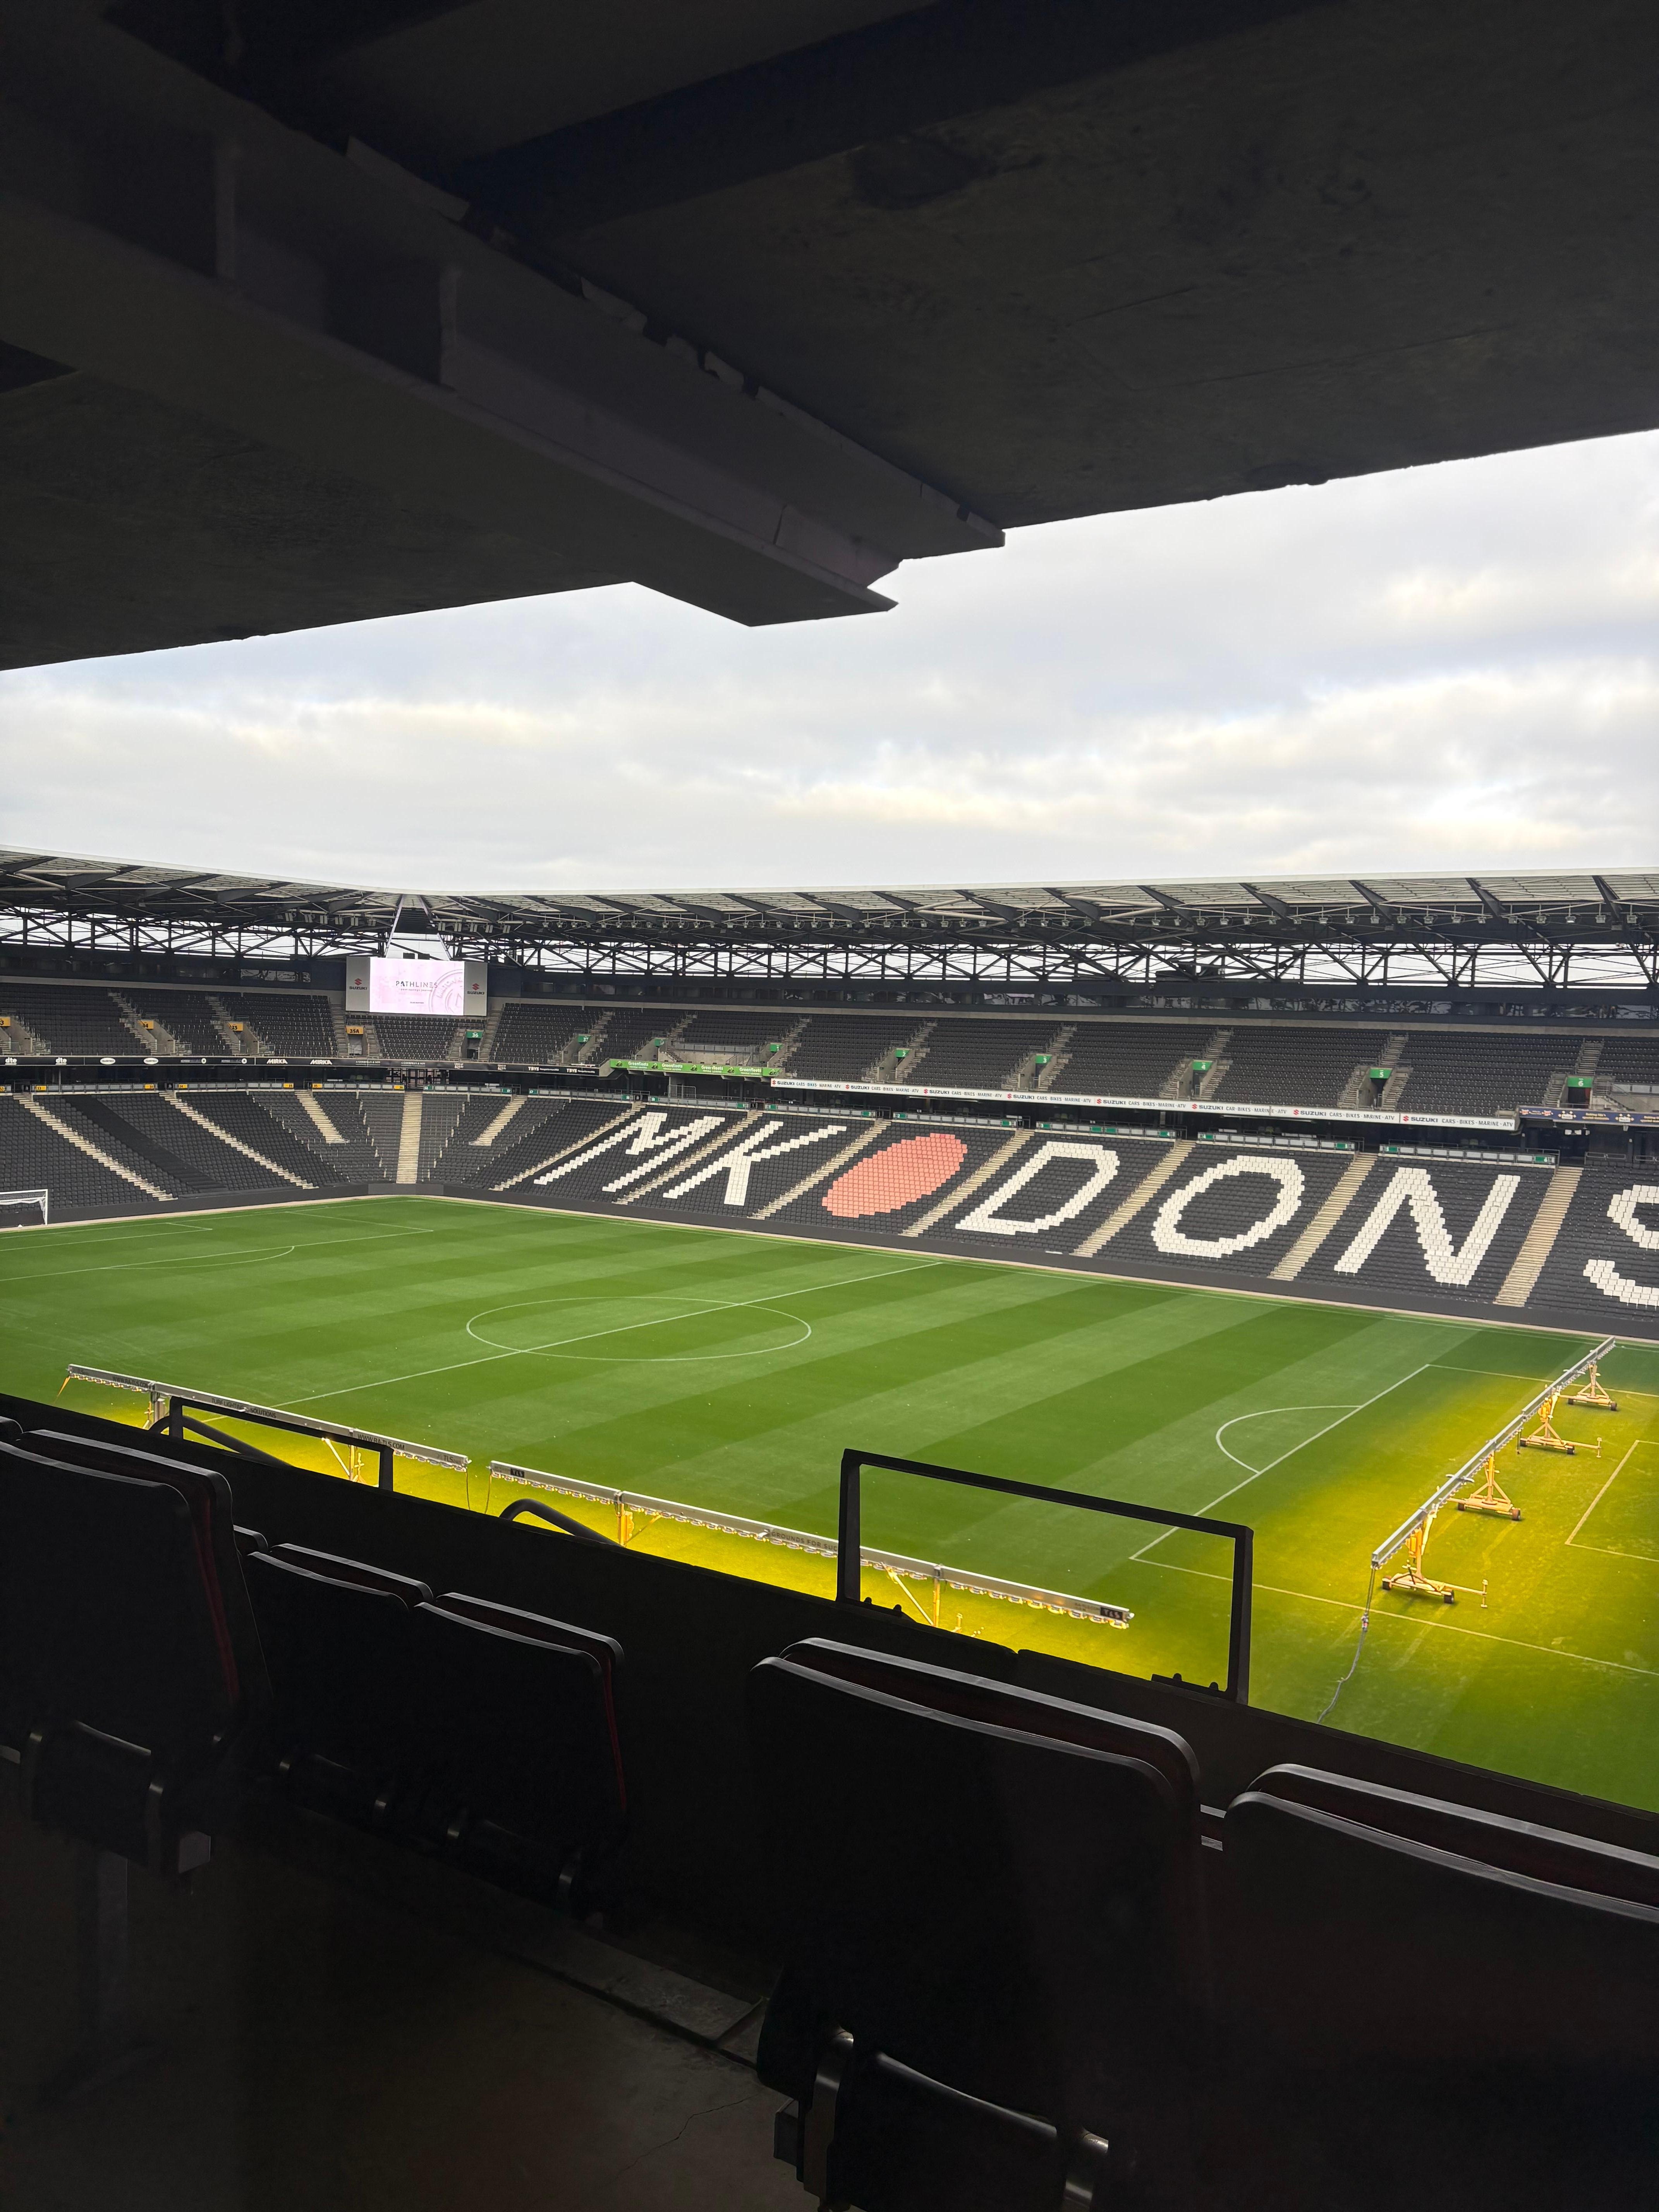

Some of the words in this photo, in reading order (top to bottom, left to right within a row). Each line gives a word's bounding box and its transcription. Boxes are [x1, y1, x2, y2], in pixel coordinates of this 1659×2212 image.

[534, 1112, 847, 1205] MK
[955, 1141, 1659, 1306] DONS
[250, 1408, 276, 1419] SOLUTIONS
[772, 1532, 805, 1544] GROUNDS
